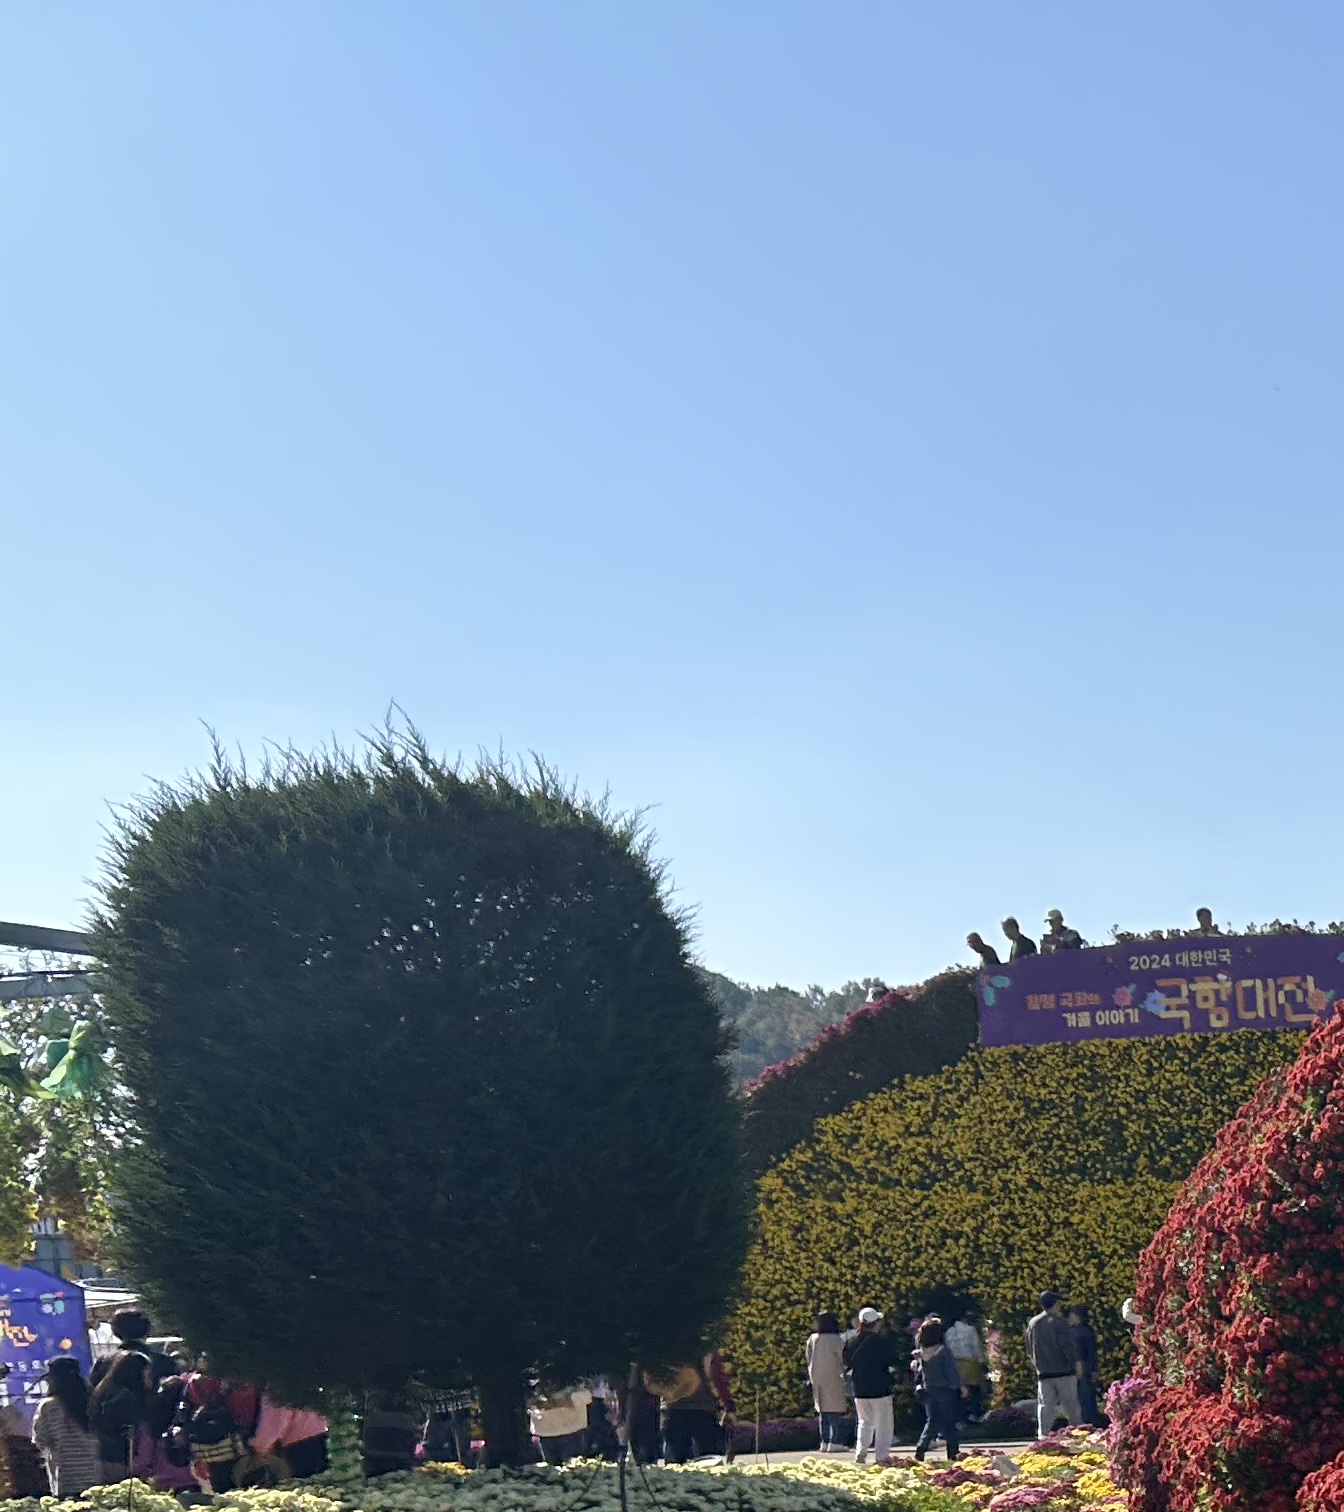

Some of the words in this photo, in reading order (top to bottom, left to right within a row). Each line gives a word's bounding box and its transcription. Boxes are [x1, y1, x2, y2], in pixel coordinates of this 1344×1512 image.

[1129, 953, 1171, 971] 2024
[1175, 948, 1232, 968] 대한민국
[1155, 974, 1317, 1030] 국향대전
[1095, 1008, 1140, 1026] 이야기
